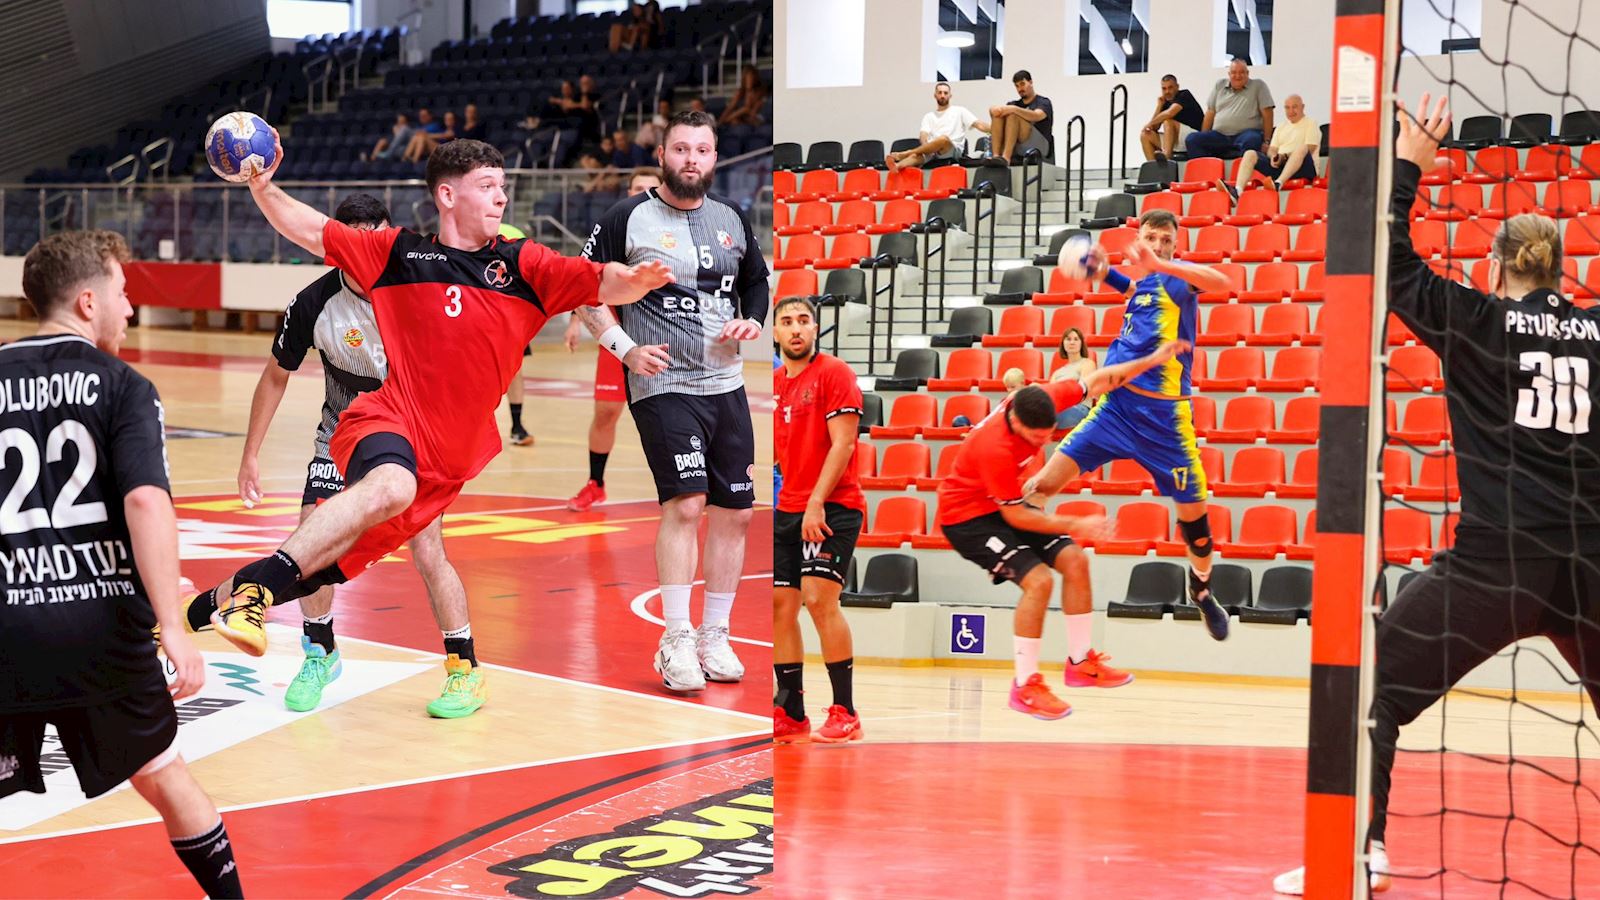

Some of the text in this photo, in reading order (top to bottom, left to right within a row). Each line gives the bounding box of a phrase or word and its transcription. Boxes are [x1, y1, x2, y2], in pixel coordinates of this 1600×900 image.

[406, 251, 448, 262] GIVOVA
[688, 245, 713, 270] 15
[444, 285, 462, 318] 3
[662, 296, 731, 311] EQUIP
[1514, 351, 1592, 434] 30
[0, 419, 108, 535] 22
